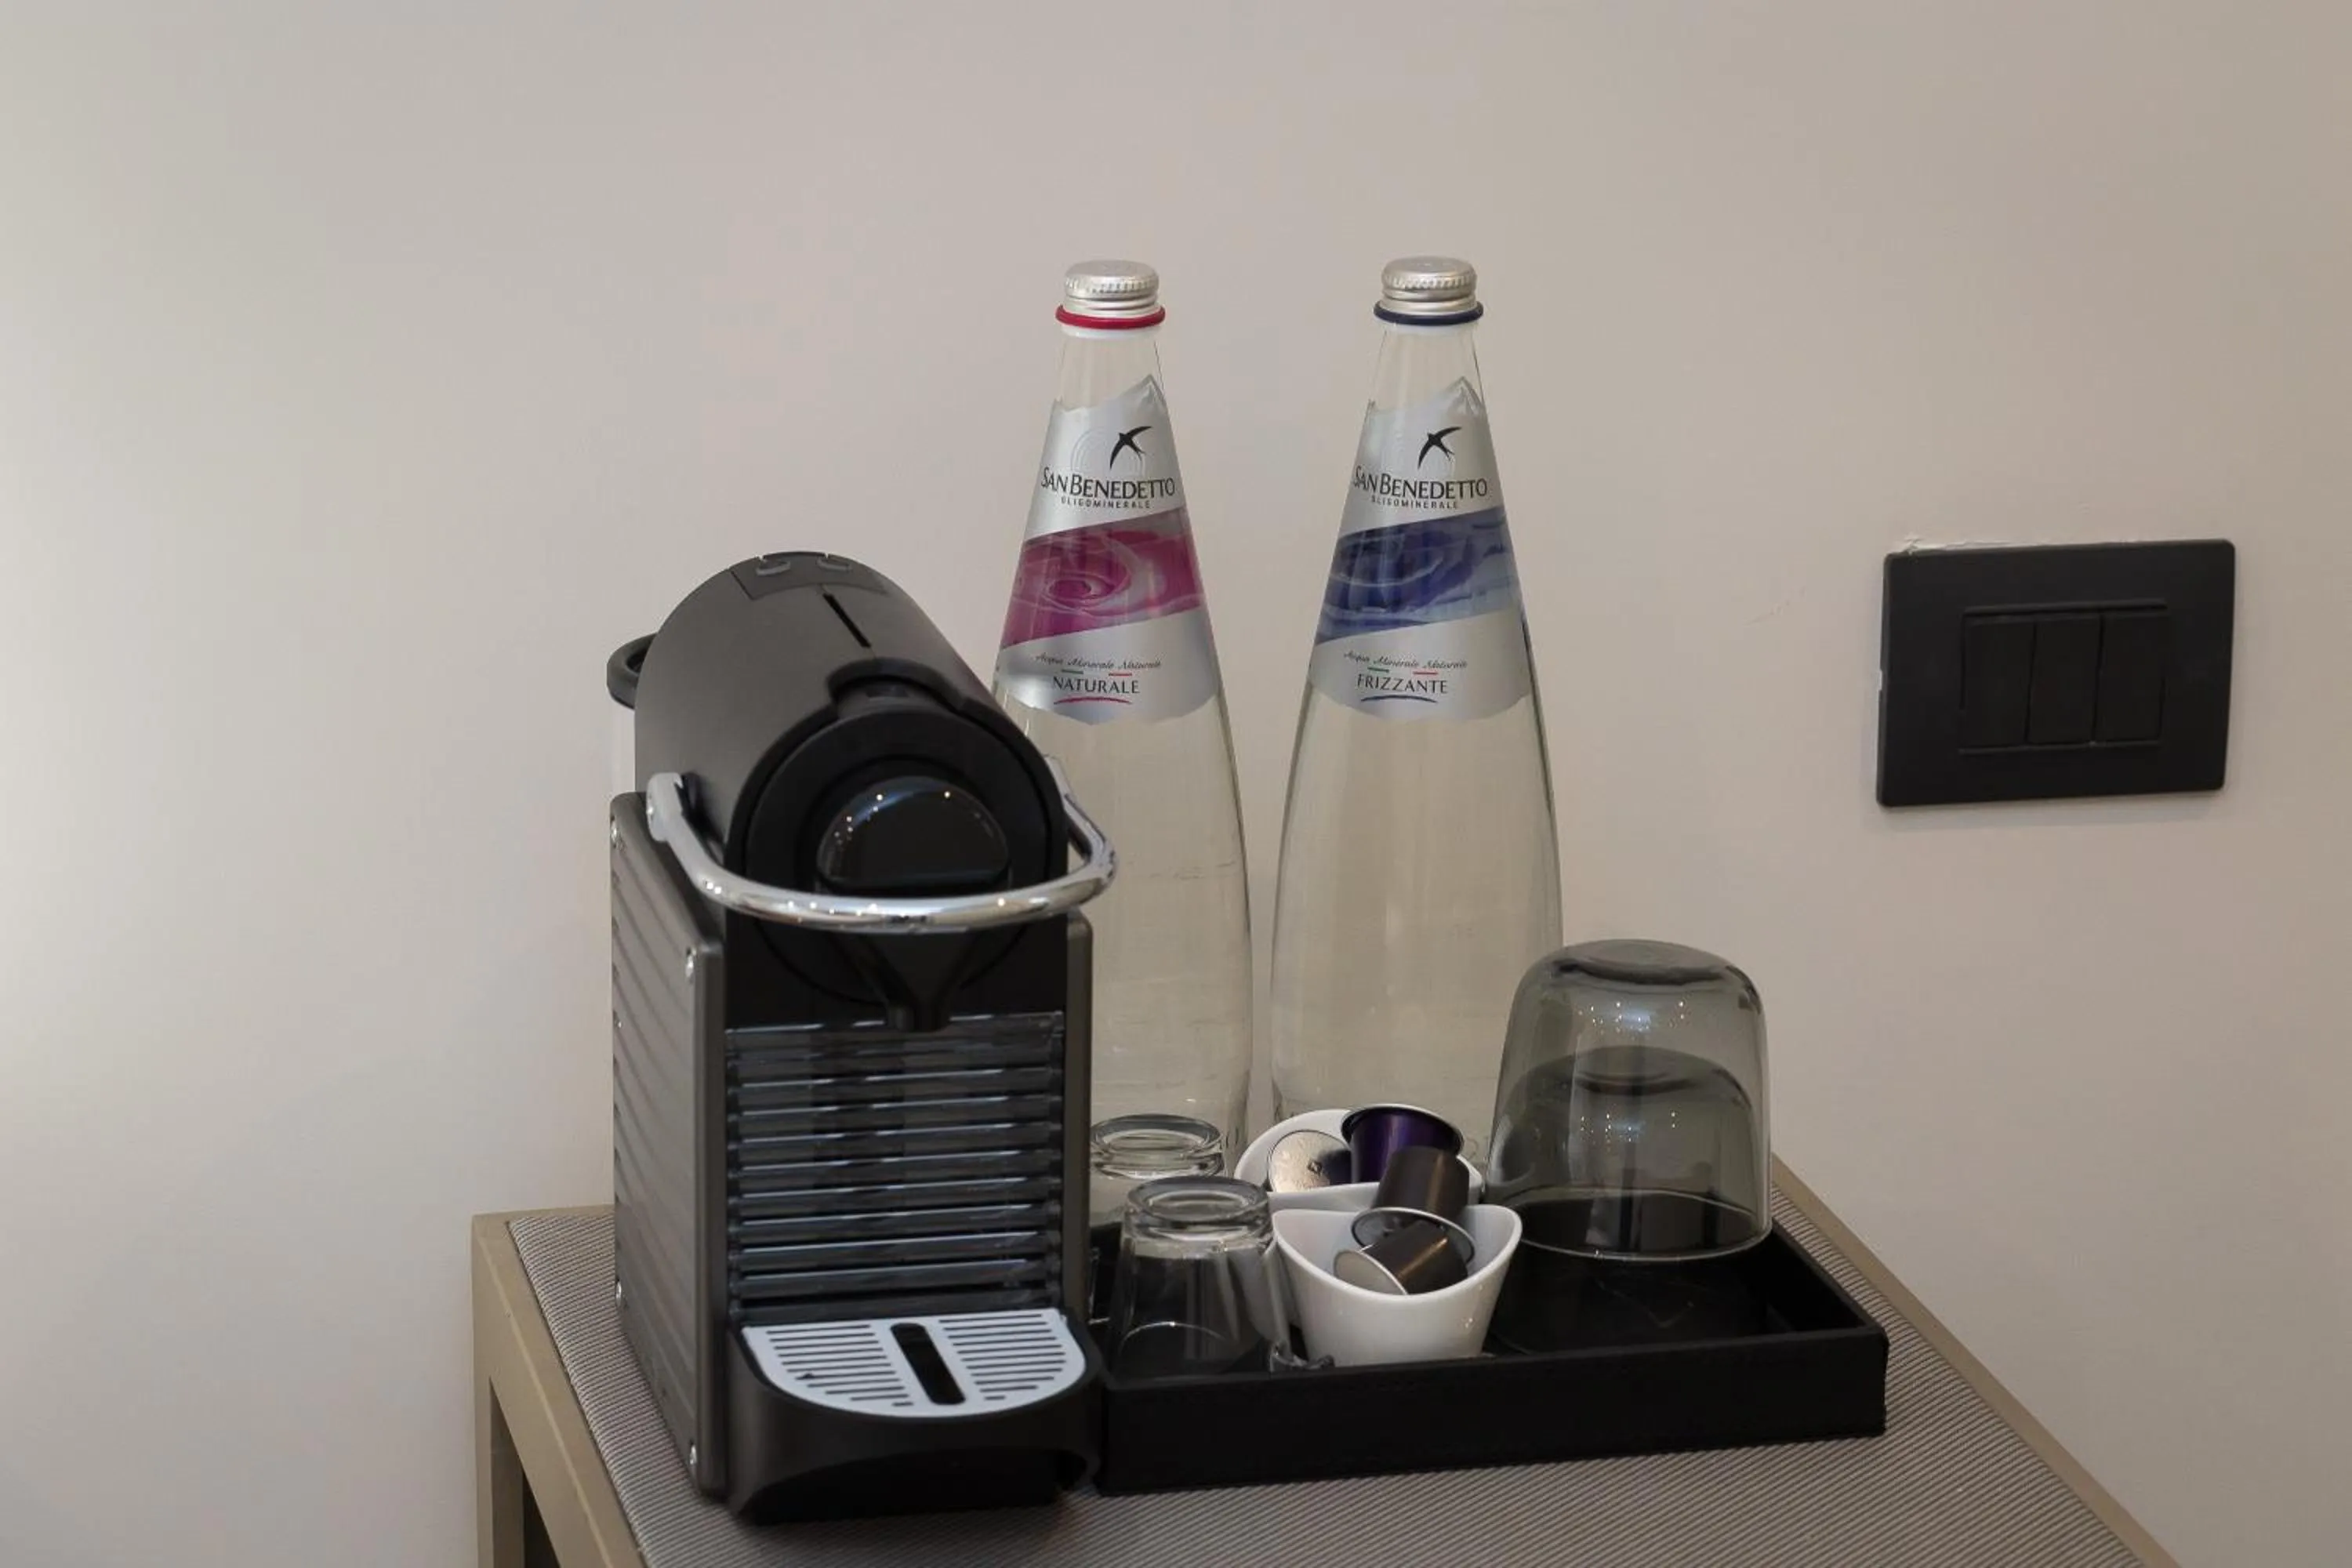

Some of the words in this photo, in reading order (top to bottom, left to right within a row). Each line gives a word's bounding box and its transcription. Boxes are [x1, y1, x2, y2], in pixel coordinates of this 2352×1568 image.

[1041, 466, 1069, 492] SAN
[1070, 474, 1175, 499] BENEDETTO
[1353, 465, 1377, 493] SAN
[1380, 473, 1487, 499] BENEDETTO
[1061, 495, 1150, 509] OLIGOMINERALE
[1053, 676, 1140, 694] NATURALE
[1357, 673, 1448, 694] FRIZZANTE
